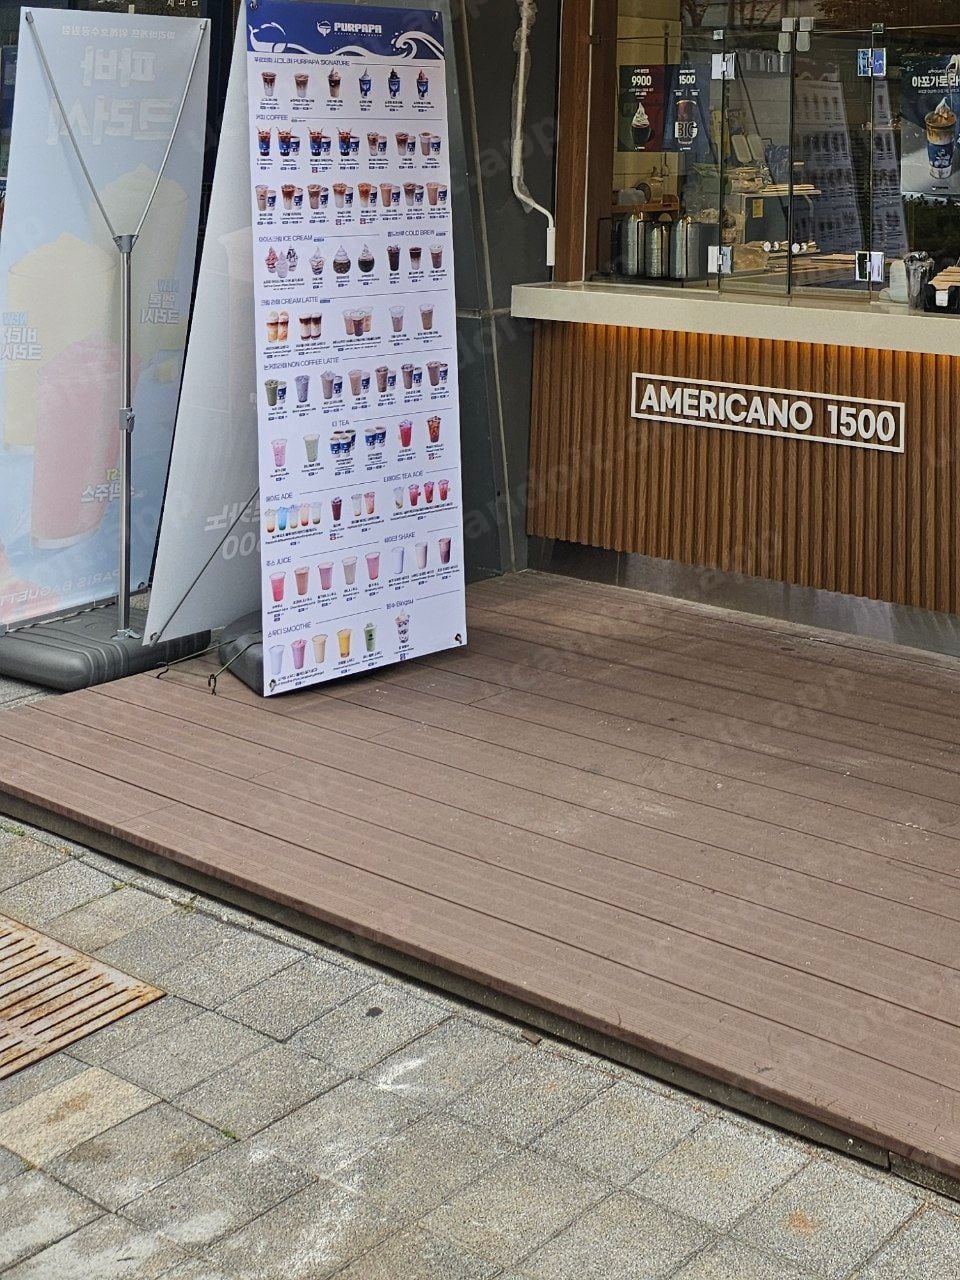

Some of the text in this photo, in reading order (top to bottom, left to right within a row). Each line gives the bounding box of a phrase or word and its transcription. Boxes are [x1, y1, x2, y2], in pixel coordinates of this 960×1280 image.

[334, 22, 382, 34] PURPAPA
[631, 75, 652, 86] 9900
[679, 74, 696, 85] 1500
[911, 75, 948, 88] 아포가토
[675, 121, 698, 139] BIG
[300, 359, 322, 367] COFFEE
[640, 383, 896, 442] AMERICANO 1500
[280, 492, 293, 500] ADE
[398, 532, 416, 542] SHAKE
[276, 556, 291, 566] JUICE
[283, 622, 312, 634] SMOOTHIE
